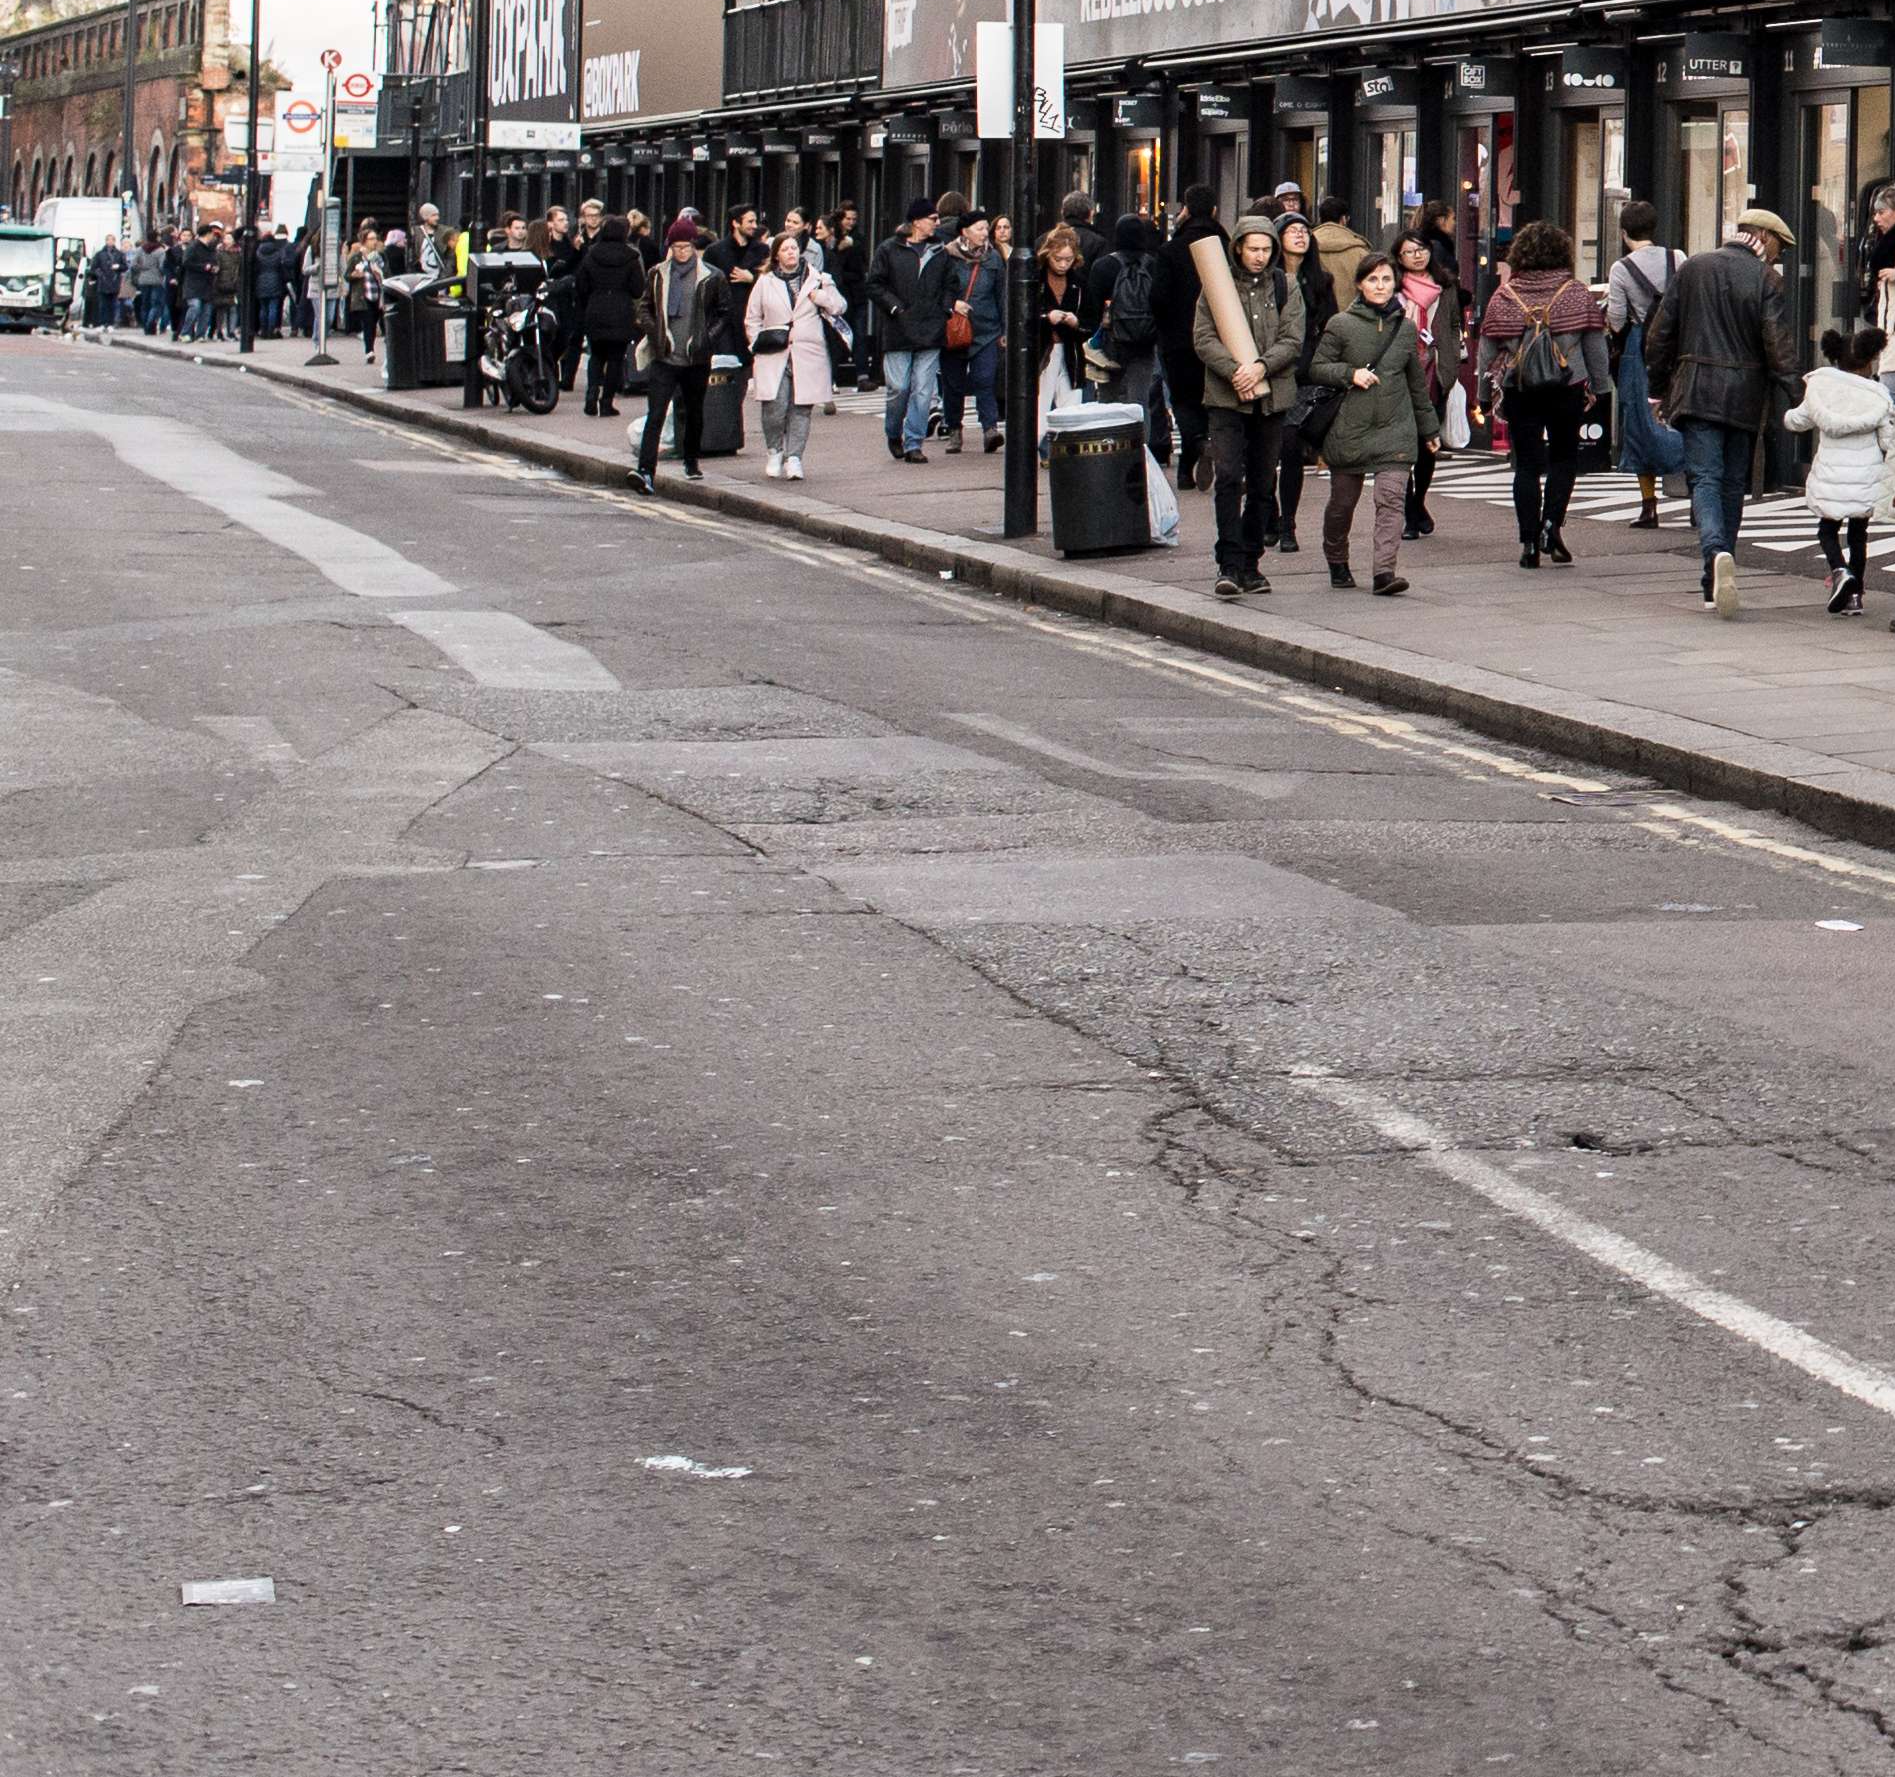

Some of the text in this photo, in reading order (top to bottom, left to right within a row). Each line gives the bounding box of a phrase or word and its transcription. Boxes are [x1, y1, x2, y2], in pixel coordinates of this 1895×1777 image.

[324, 52, 338, 68] K
[1690, 61, 1728, 73] UTTER
[1784, 50, 1795, 72] 11
[1463, 75, 1482, 84] BOX
[1657, 61, 1667, 84] 12
[584, 49, 640, 118] @BOXPARK
